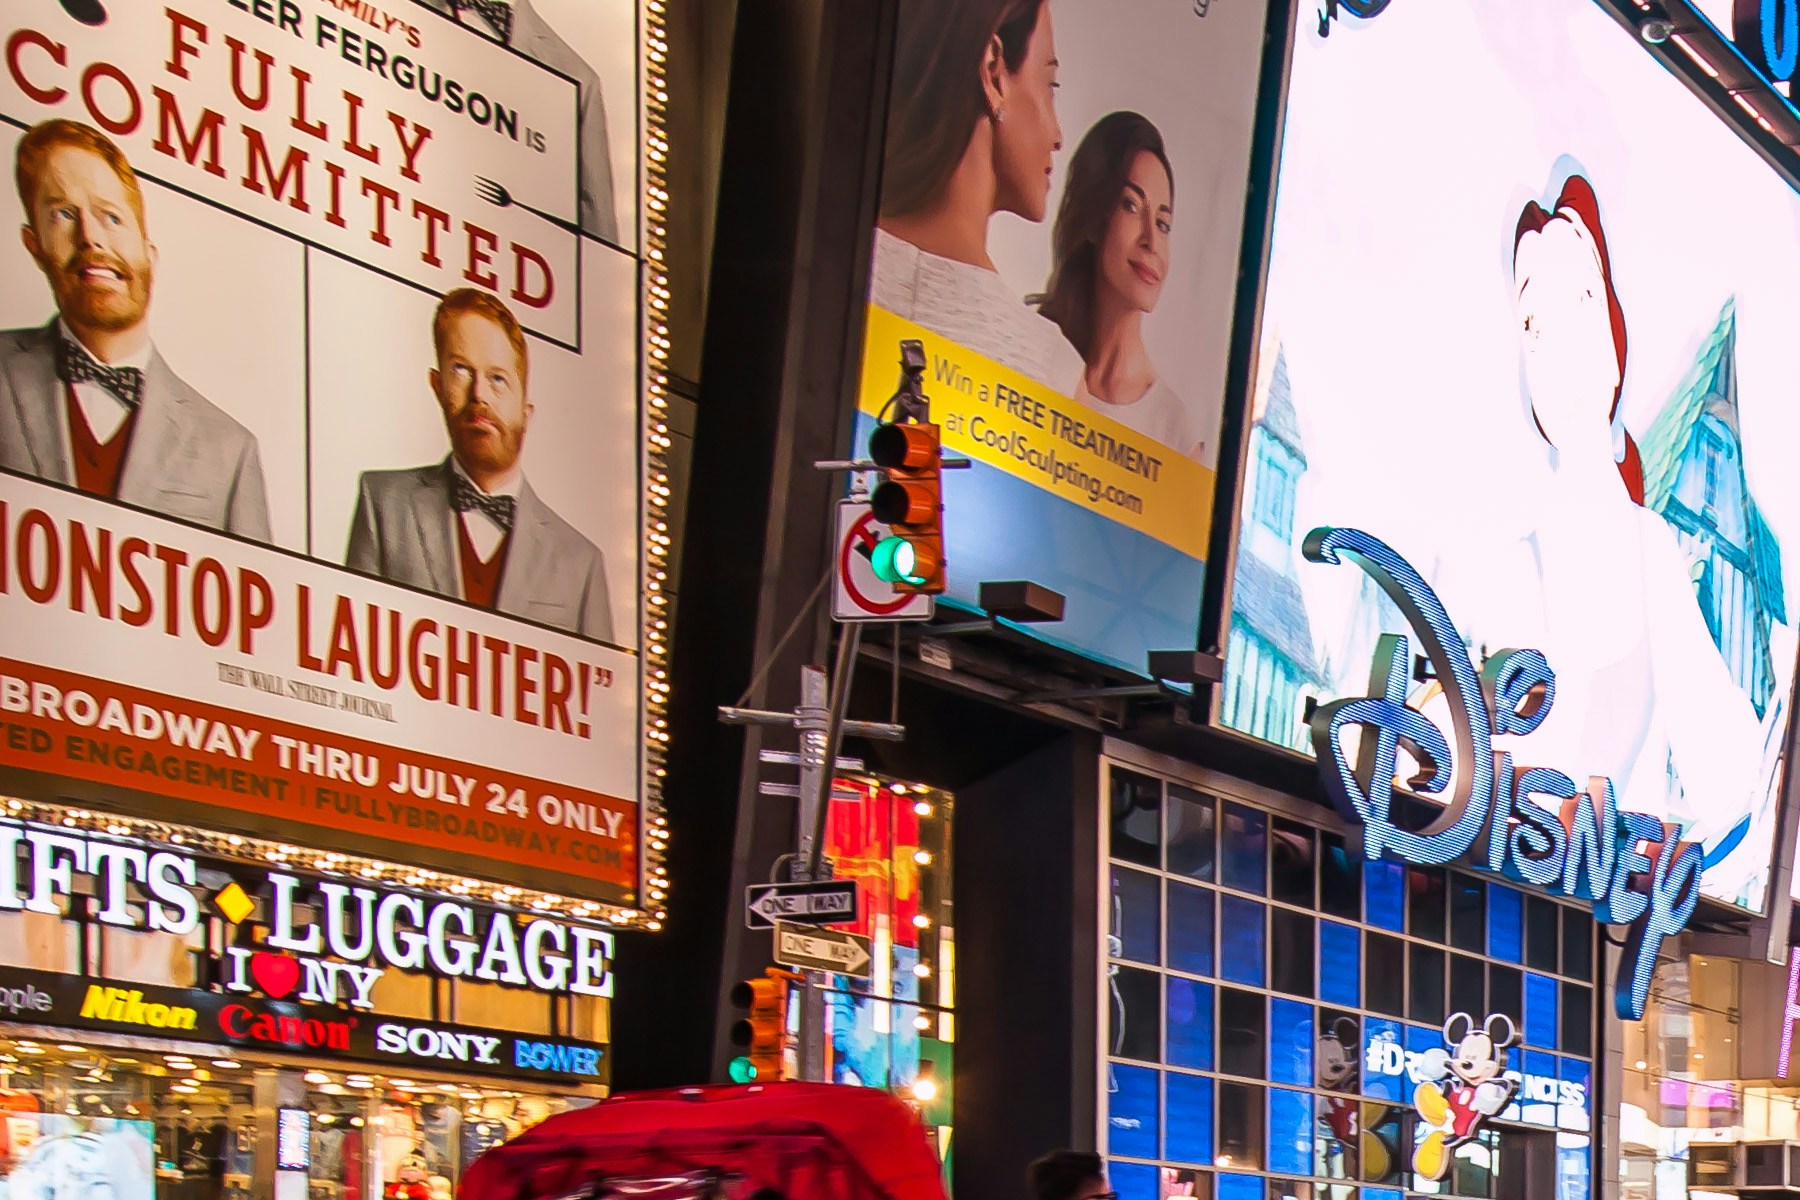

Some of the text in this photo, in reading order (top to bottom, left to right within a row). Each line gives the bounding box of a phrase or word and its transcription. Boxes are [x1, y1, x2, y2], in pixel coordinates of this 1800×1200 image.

[164, 5, 434, 184] FULLY
[314, 14, 519, 142] FERGUSON
[524, 126, 548, 154] IS
[5, 28, 555, 309] COMMITTED
[934, 354, 1163, 483] Win a FREE TREATMENT
[945, 412, 1144, 515] at CoolSculpting.com
[0, 505, 615, 741] ONSTOP LAUGHTER!”
[0, 677, 625, 839] BROADWAY THRU JULY 24 ONLY
[0, 720, 623, 870] ED ENGAGEMENT FULLYBROADWAY.COM
[226, 947, 385, 1010] I NY
[267, 872, 616, 999] LUGGAGE
[80, 985, 198, 1031] Nikon
[218, 1003, 351, 1050] Canon
[375, 1023, 502, 1065] SONY
[513, 1039, 604, 1077] BOWER
